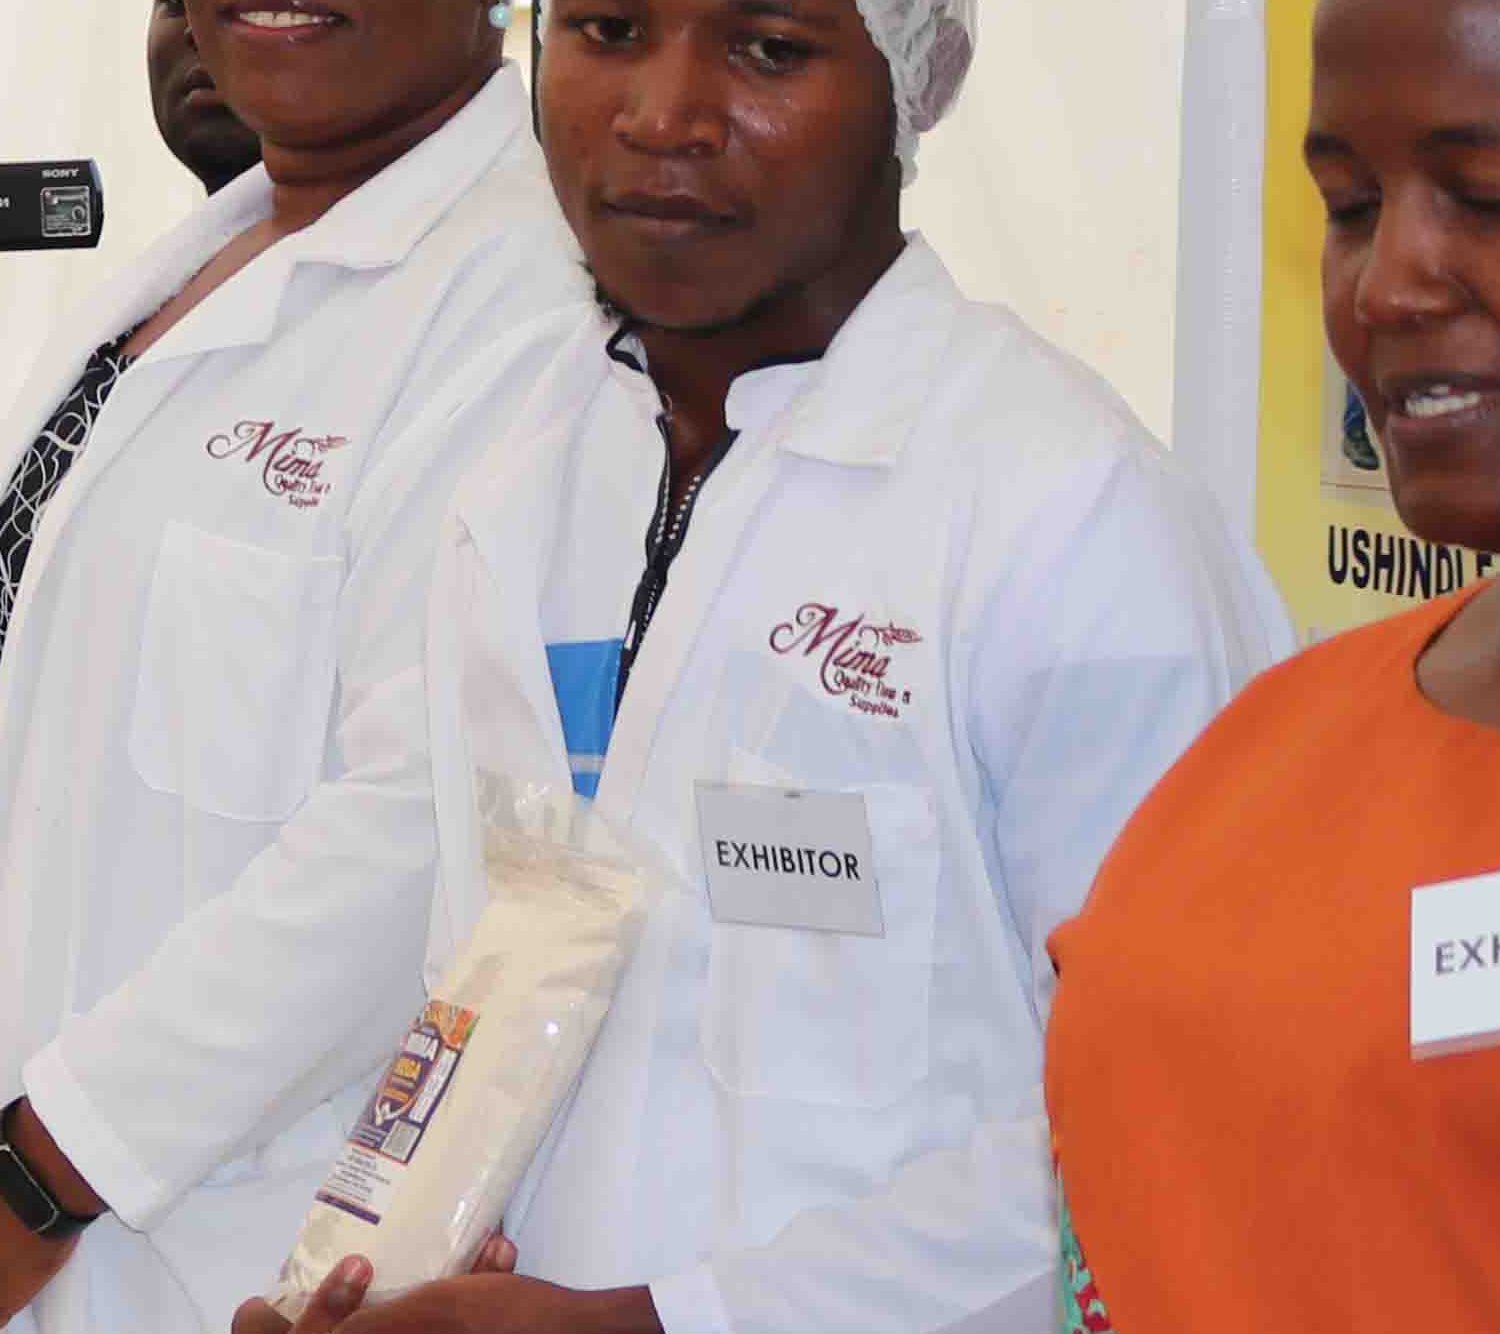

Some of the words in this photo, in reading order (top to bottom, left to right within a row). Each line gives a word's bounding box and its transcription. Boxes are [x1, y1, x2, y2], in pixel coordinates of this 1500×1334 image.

[42, 167, 80, 179] SONY
[1328, 524, 1464, 600] USHINDI
[715, 839, 861, 881] EXHIBITOR
